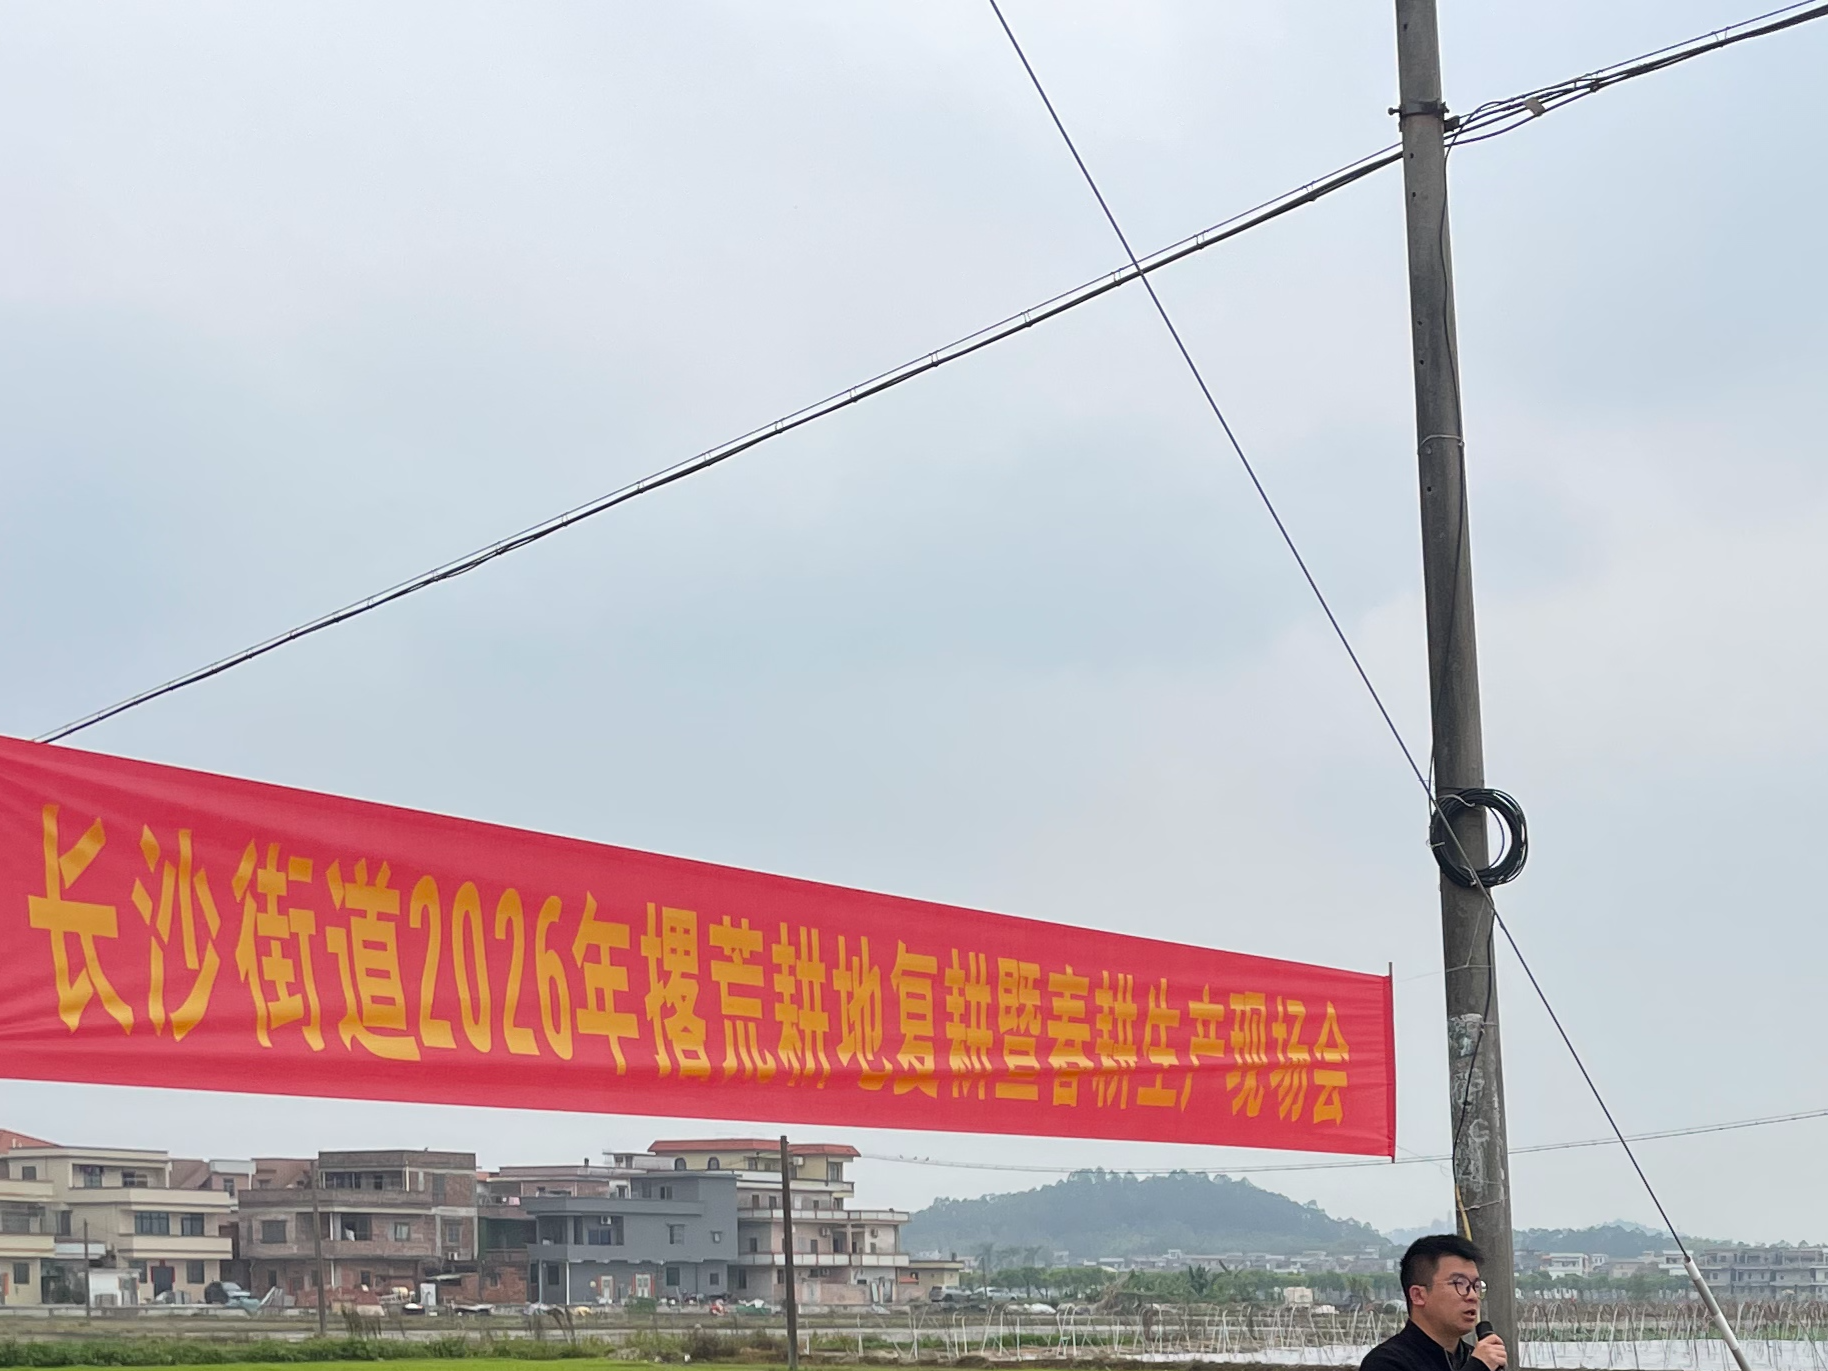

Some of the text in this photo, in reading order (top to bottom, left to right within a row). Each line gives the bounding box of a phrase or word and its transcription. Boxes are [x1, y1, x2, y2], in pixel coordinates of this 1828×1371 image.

[28, 804, 1351, 1126] 长沙街道2026年撂荒耕地复耕暨春耕生产现场会
